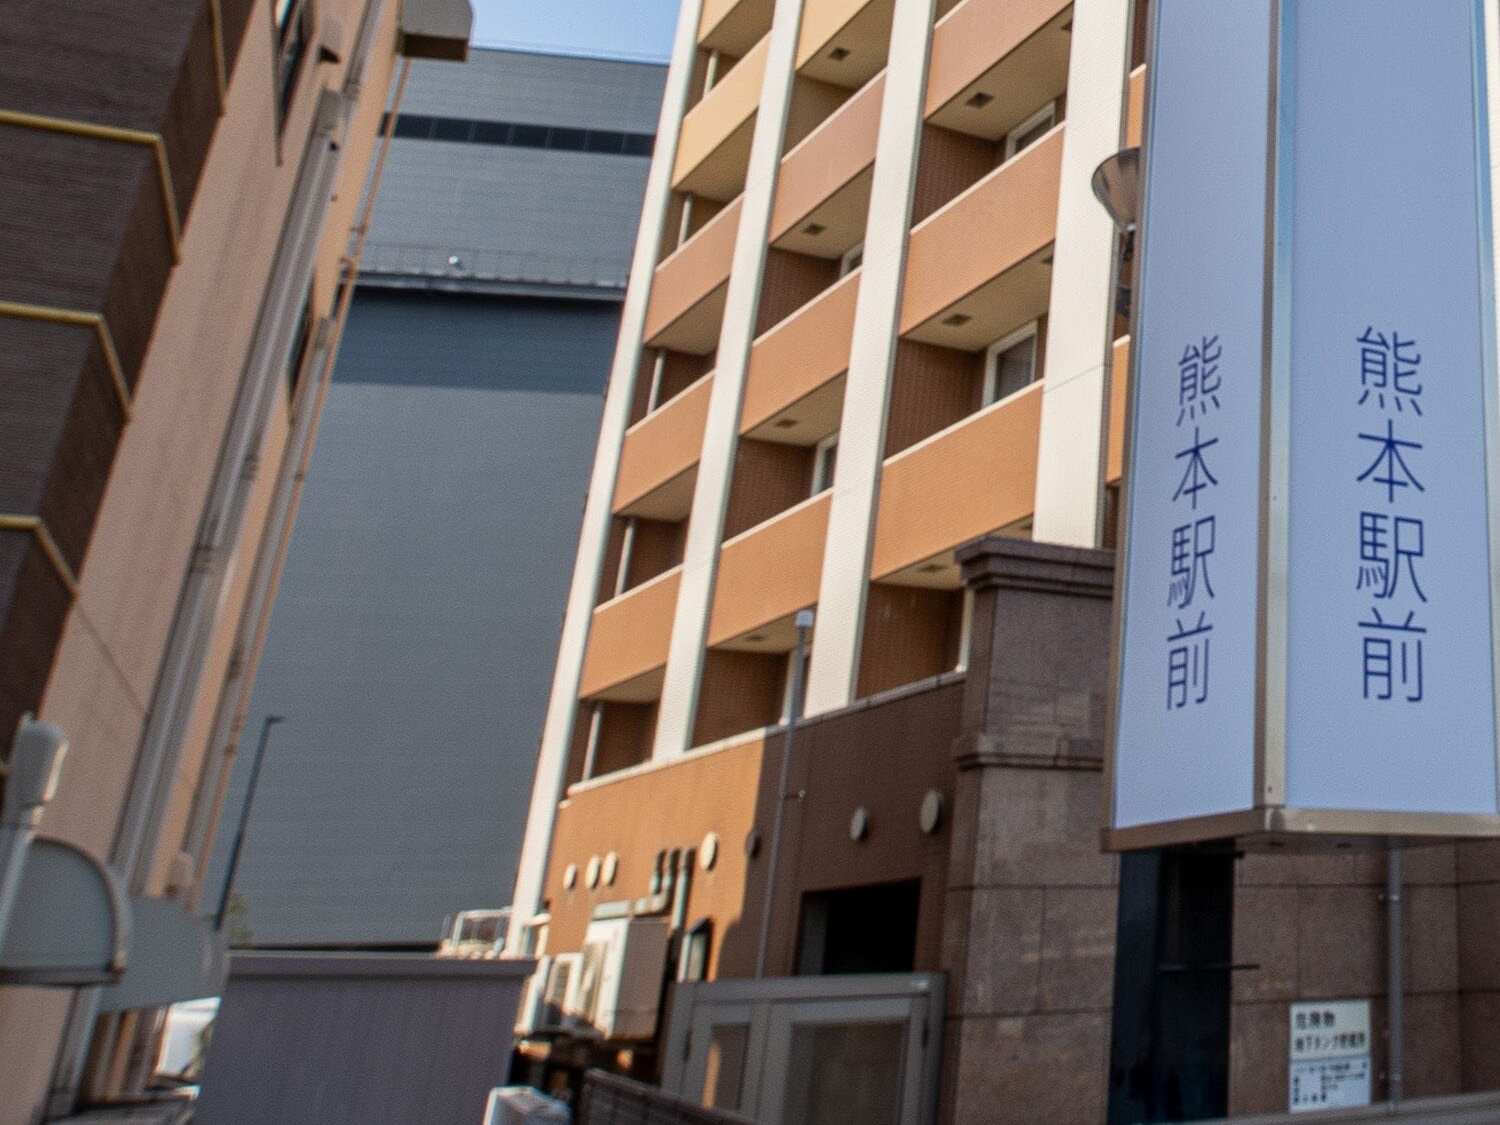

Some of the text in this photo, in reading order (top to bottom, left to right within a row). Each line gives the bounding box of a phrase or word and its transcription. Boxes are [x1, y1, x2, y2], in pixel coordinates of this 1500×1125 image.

[1167, 335, 1223, 711] 熊本駅前
[1356, 325, 1428, 704] 熊本駅前
